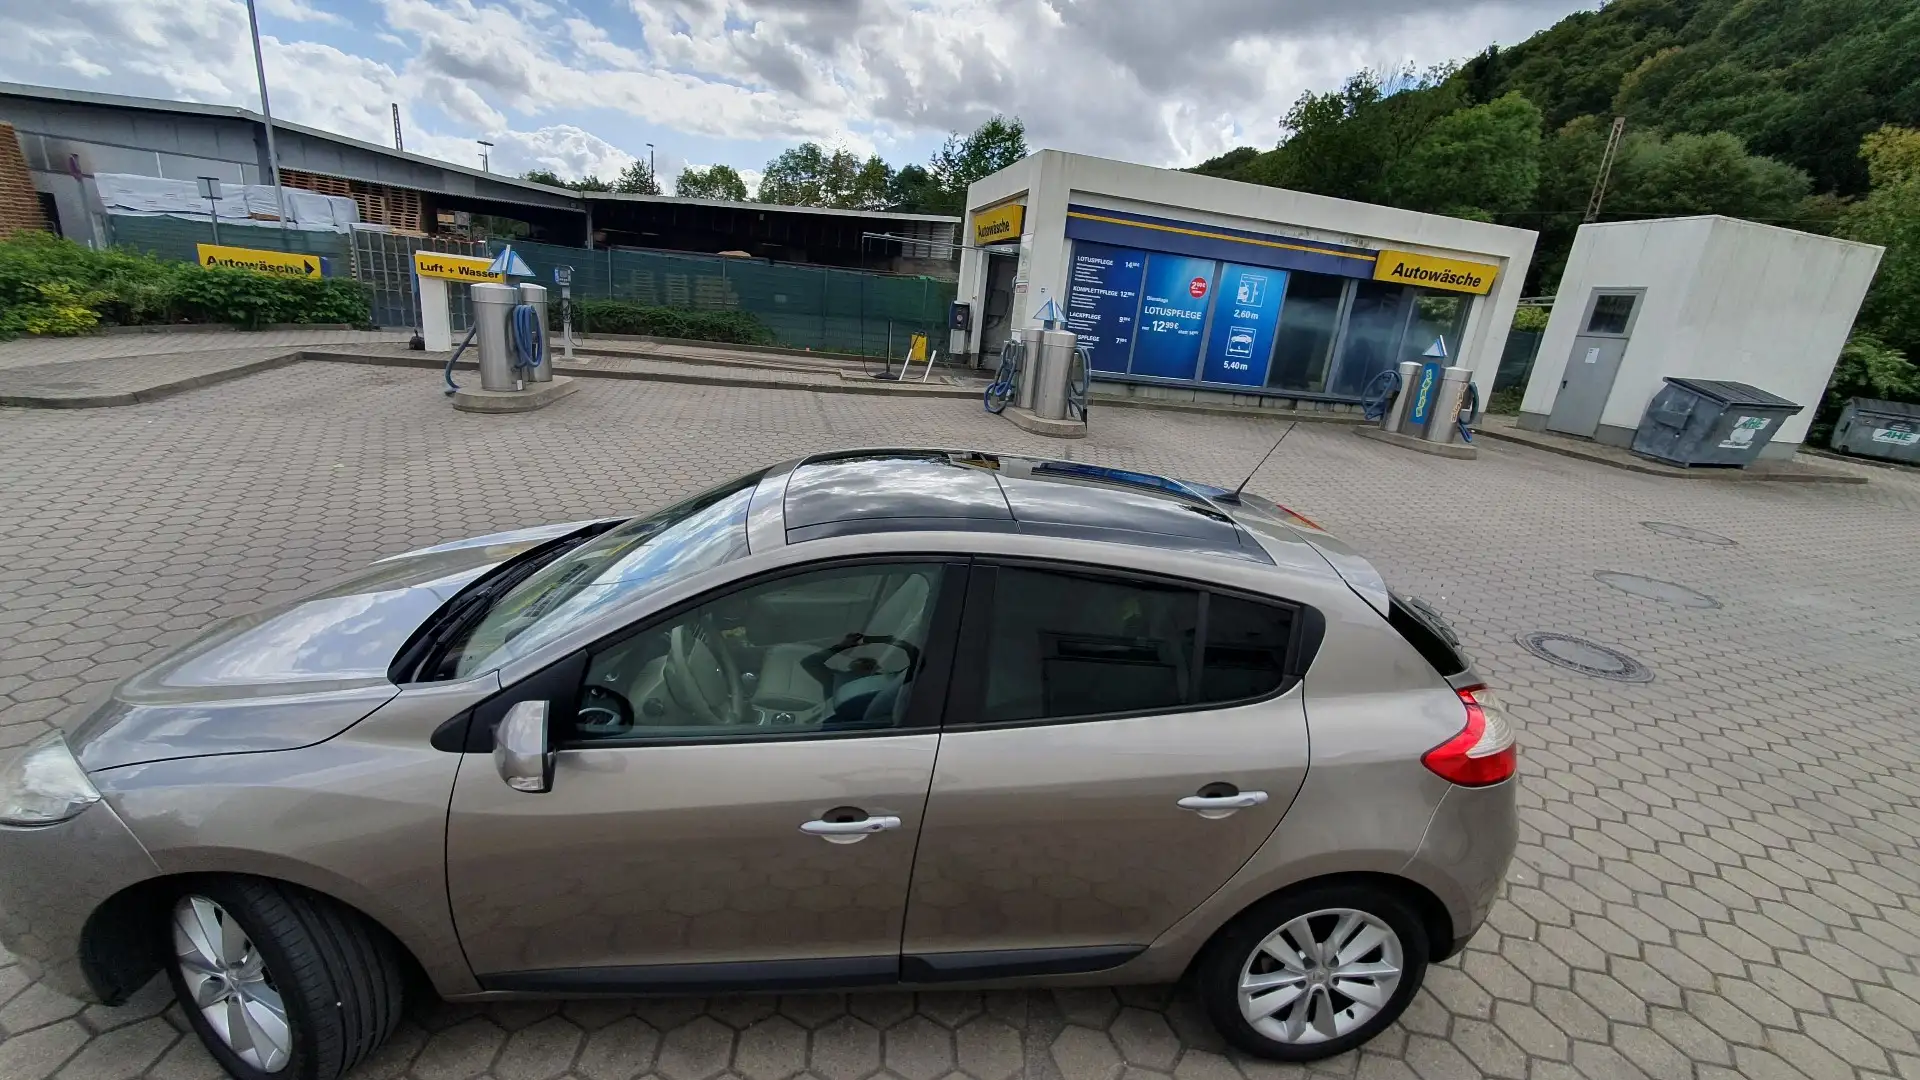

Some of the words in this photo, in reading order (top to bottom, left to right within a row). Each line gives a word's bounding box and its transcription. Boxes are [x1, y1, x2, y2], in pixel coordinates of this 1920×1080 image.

[206, 255, 303, 275] Autowäsche
[1077, 255, 1114, 266] LOTUSPFLEGE
[420, 261, 444, 273] Luft
[458, 266, 500, 279] Wasser
[1391, 262, 1482, 288] Autowäsche
[1072, 285, 1118, 297] KOMPLETTPFLEGE
[1069, 311, 1102, 320] LACKPFLEGE
[1144, 305, 1203, 320] LOTUSPFLEGE
[1879, 430, 1912, 441] AHE
